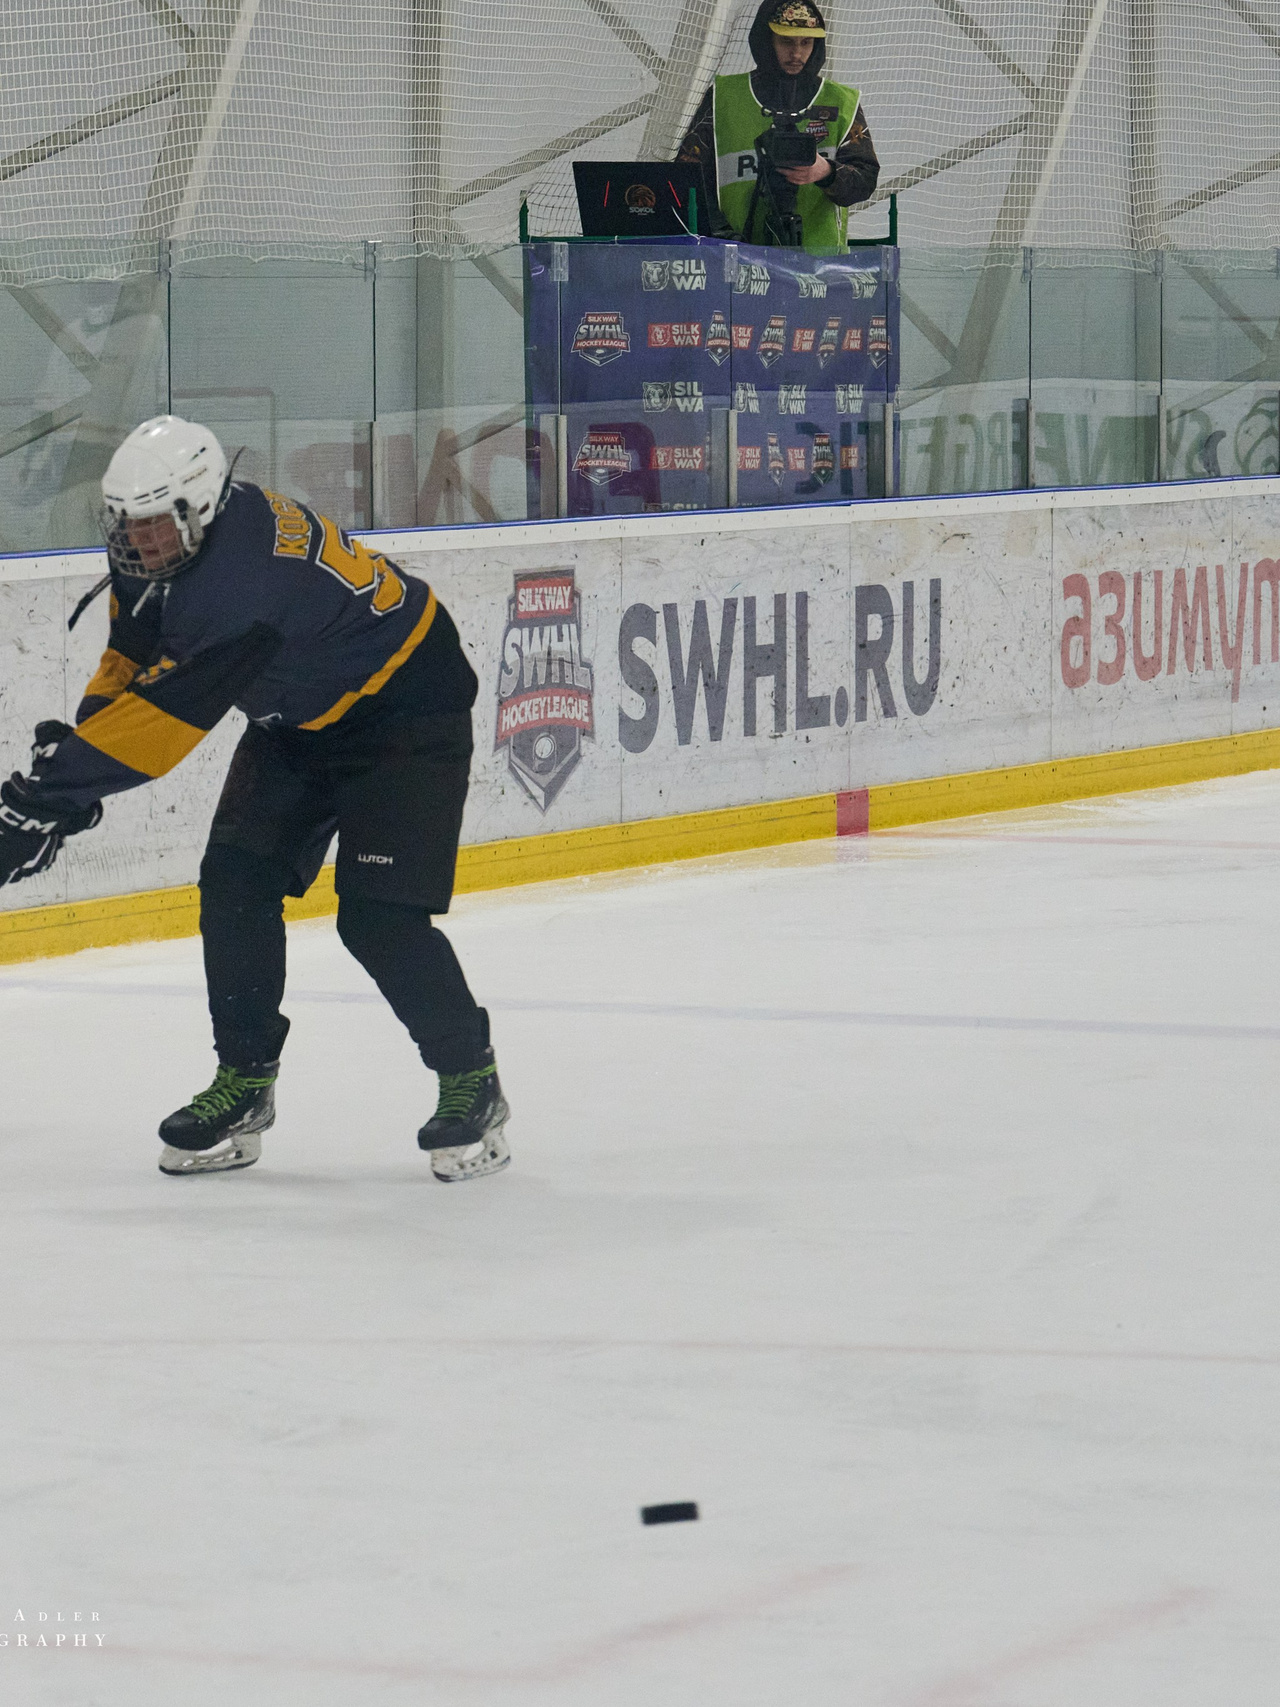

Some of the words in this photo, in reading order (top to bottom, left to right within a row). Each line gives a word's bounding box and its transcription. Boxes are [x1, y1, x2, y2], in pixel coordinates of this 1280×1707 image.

[577, 324, 628, 340] SWHL
[672, 324, 700, 335] SILK
[576, 339, 602, 348] HOCKEY
[602, 339, 627, 348] LEAGUE
[672, 335, 700, 346] WAY
[674, 381, 703, 396] SIL
[675, 398, 704, 413] WA
[579, 444, 630, 461] SWHL
[673, 447, 702, 458] SILK
[577, 459, 603, 468] HOCKEY
[674, 458, 702, 469] WAY
[315, 508, 407, 616] 5
[518, 586, 544, 612] SILK
[544, 585, 572, 610] WAY
[500, 623, 592, 698] SWHL
[618, 577, 942, 754] SWHL.RU
[502, 698, 547, 730] HOCKEY
[547, 695, 589, 722] LEAGUE
